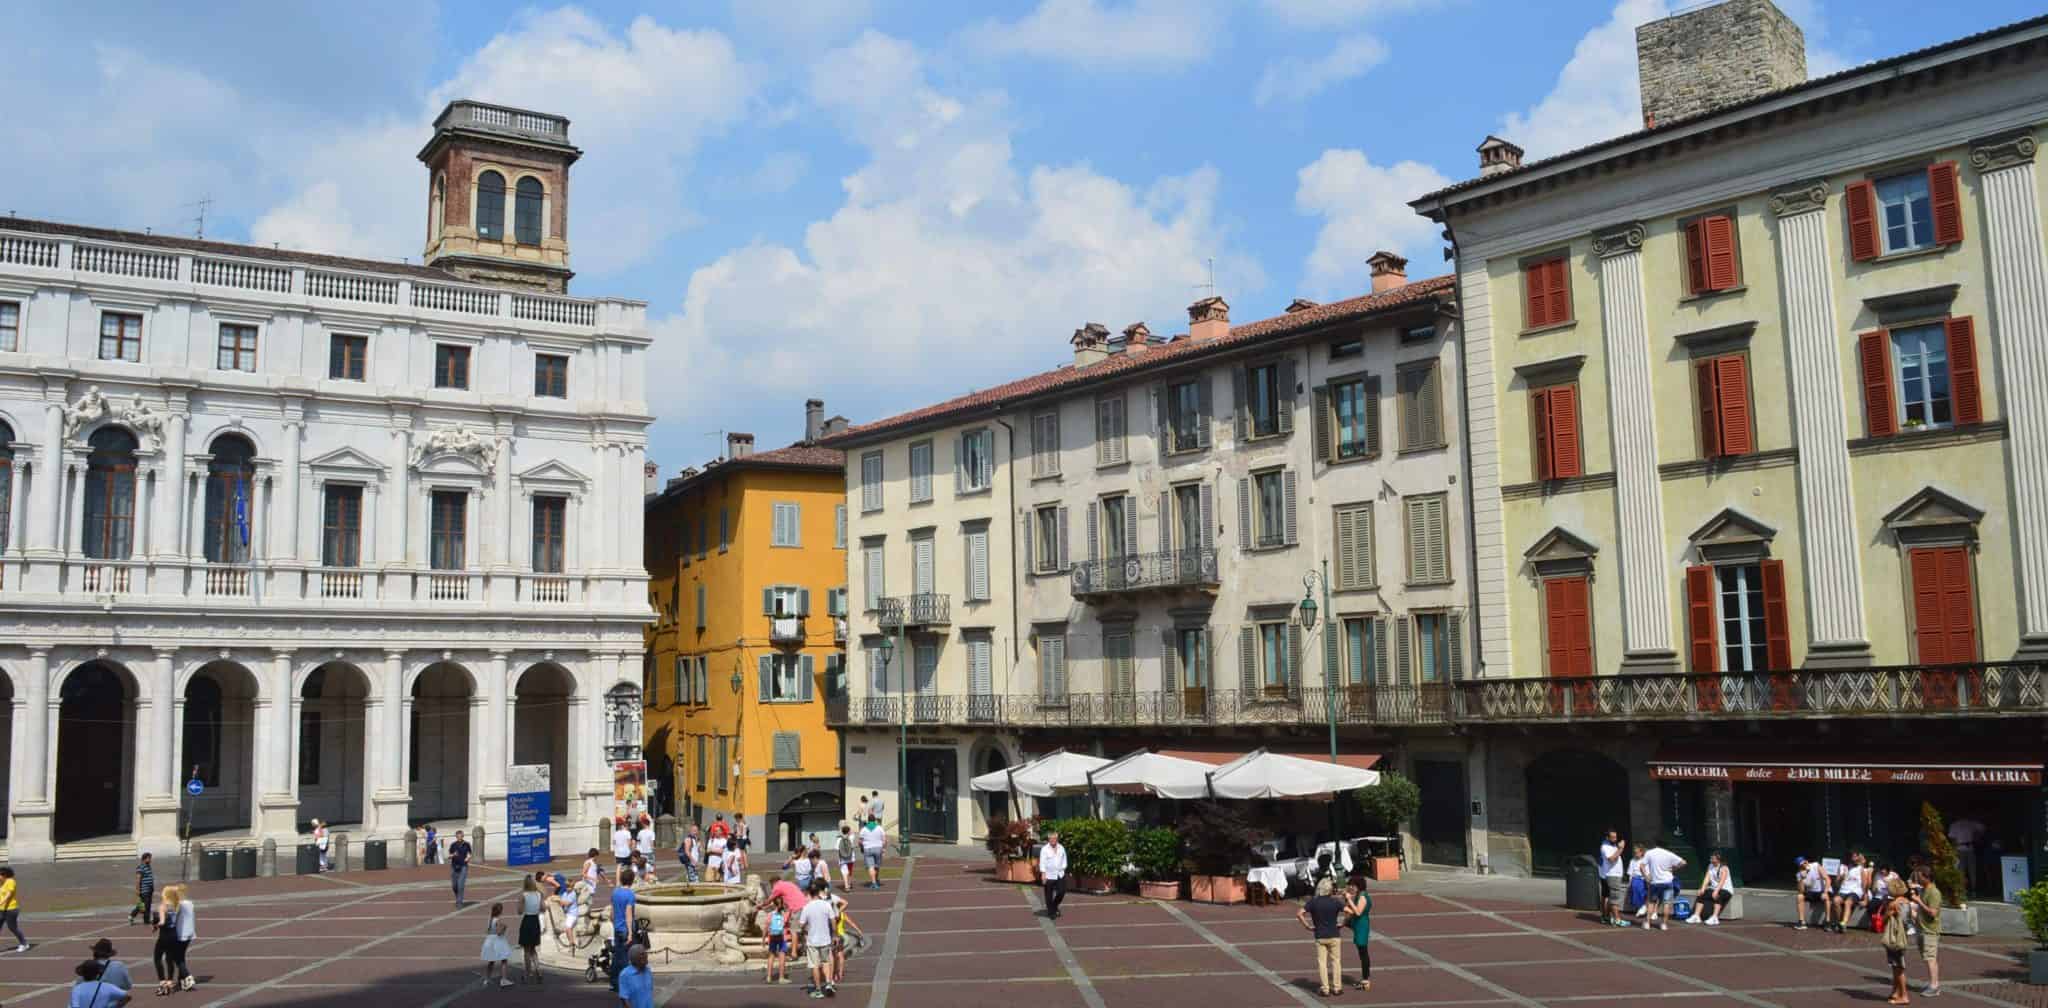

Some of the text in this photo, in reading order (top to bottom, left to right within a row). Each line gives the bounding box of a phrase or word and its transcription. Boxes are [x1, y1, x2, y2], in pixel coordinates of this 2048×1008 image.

[1657, 766, 1728, 777] PASTICCERIA
[1746, 768, 1773, 778] dolce
[1824, 768, 1860, 779] MILLE
[1951, 769, 2030, 782] GELATERIA
